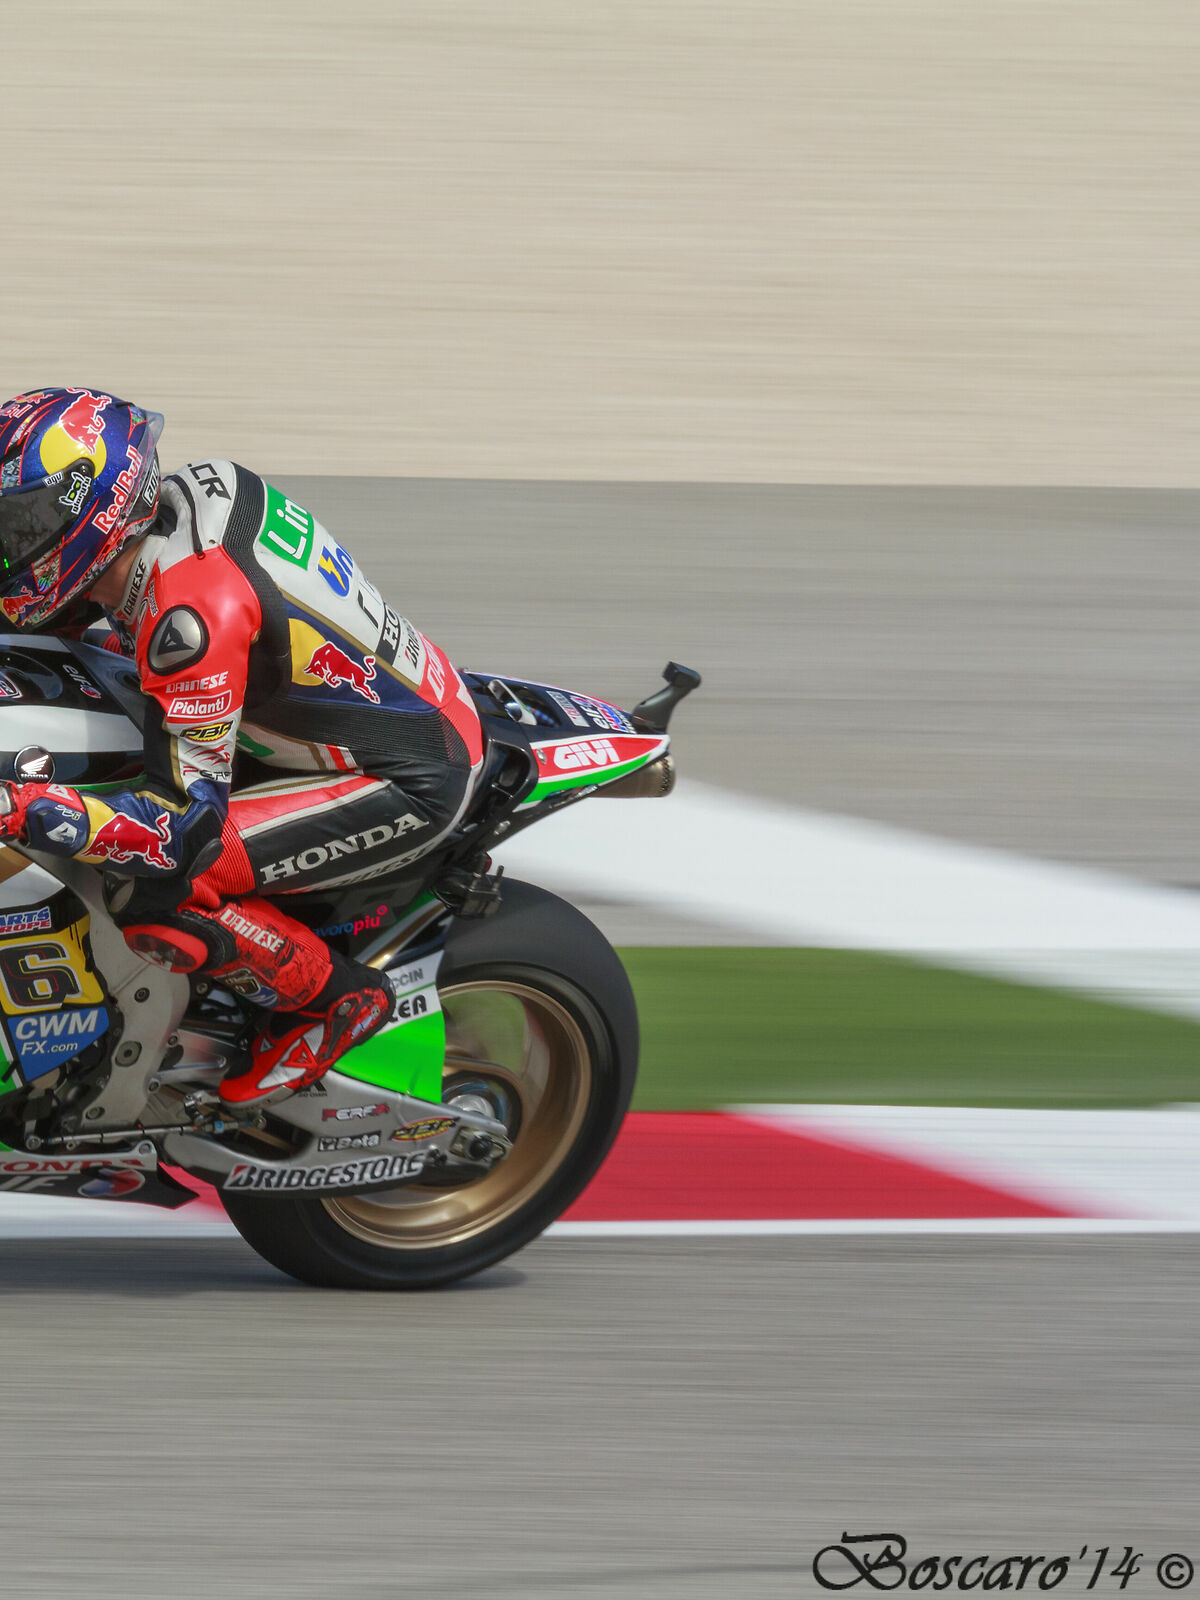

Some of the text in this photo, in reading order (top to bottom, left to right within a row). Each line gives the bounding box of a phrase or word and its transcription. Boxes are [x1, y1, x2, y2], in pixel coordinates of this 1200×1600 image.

[267, 498, 309, 561] Lin
[173, 697, 225, 715] Piolanti
[553, 739, 620, 770] GIVI
[260, 812, 429, 885] HONDA
[15, 1010, 98, 1041] CWM
[21, 1040, 78, 1055] FX.com
[337, 1133, 380, 1149] Beta
[224, 1152, 424, 1190] BRIDGESTONE
